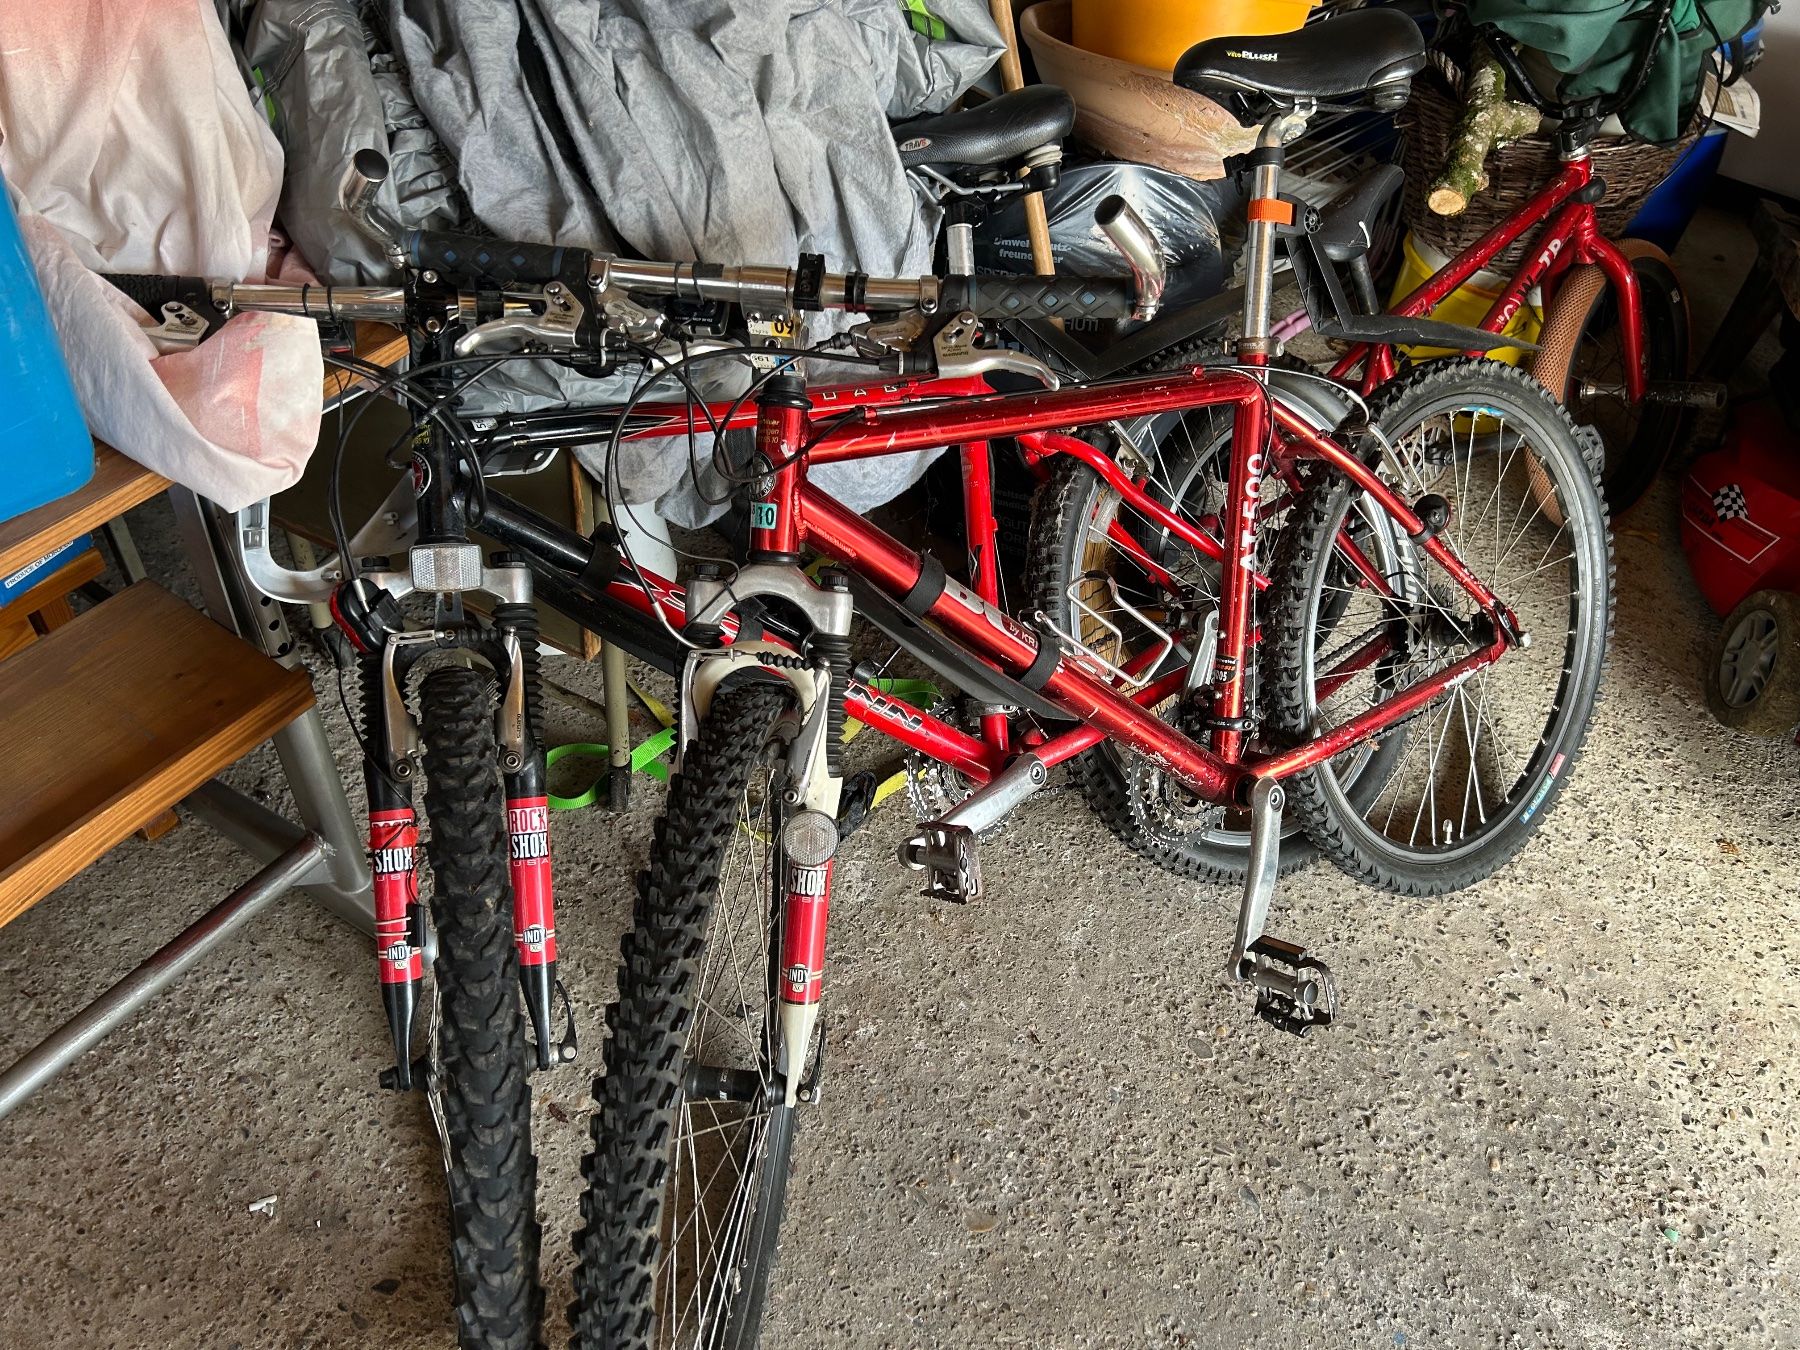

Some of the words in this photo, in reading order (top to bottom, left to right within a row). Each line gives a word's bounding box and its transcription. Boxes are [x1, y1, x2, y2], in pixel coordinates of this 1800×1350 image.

[509, 808, 547, 833] ROCK
[511, 832, 549, 860] SHOX
[375, 848, 413, 874] SHOX
[790, 868, 827, 896] SHOX
[524, 928, 546, 944] INDY
[388, 945, 412, 961] INDY
[788, 968, 811, 983] INDY
